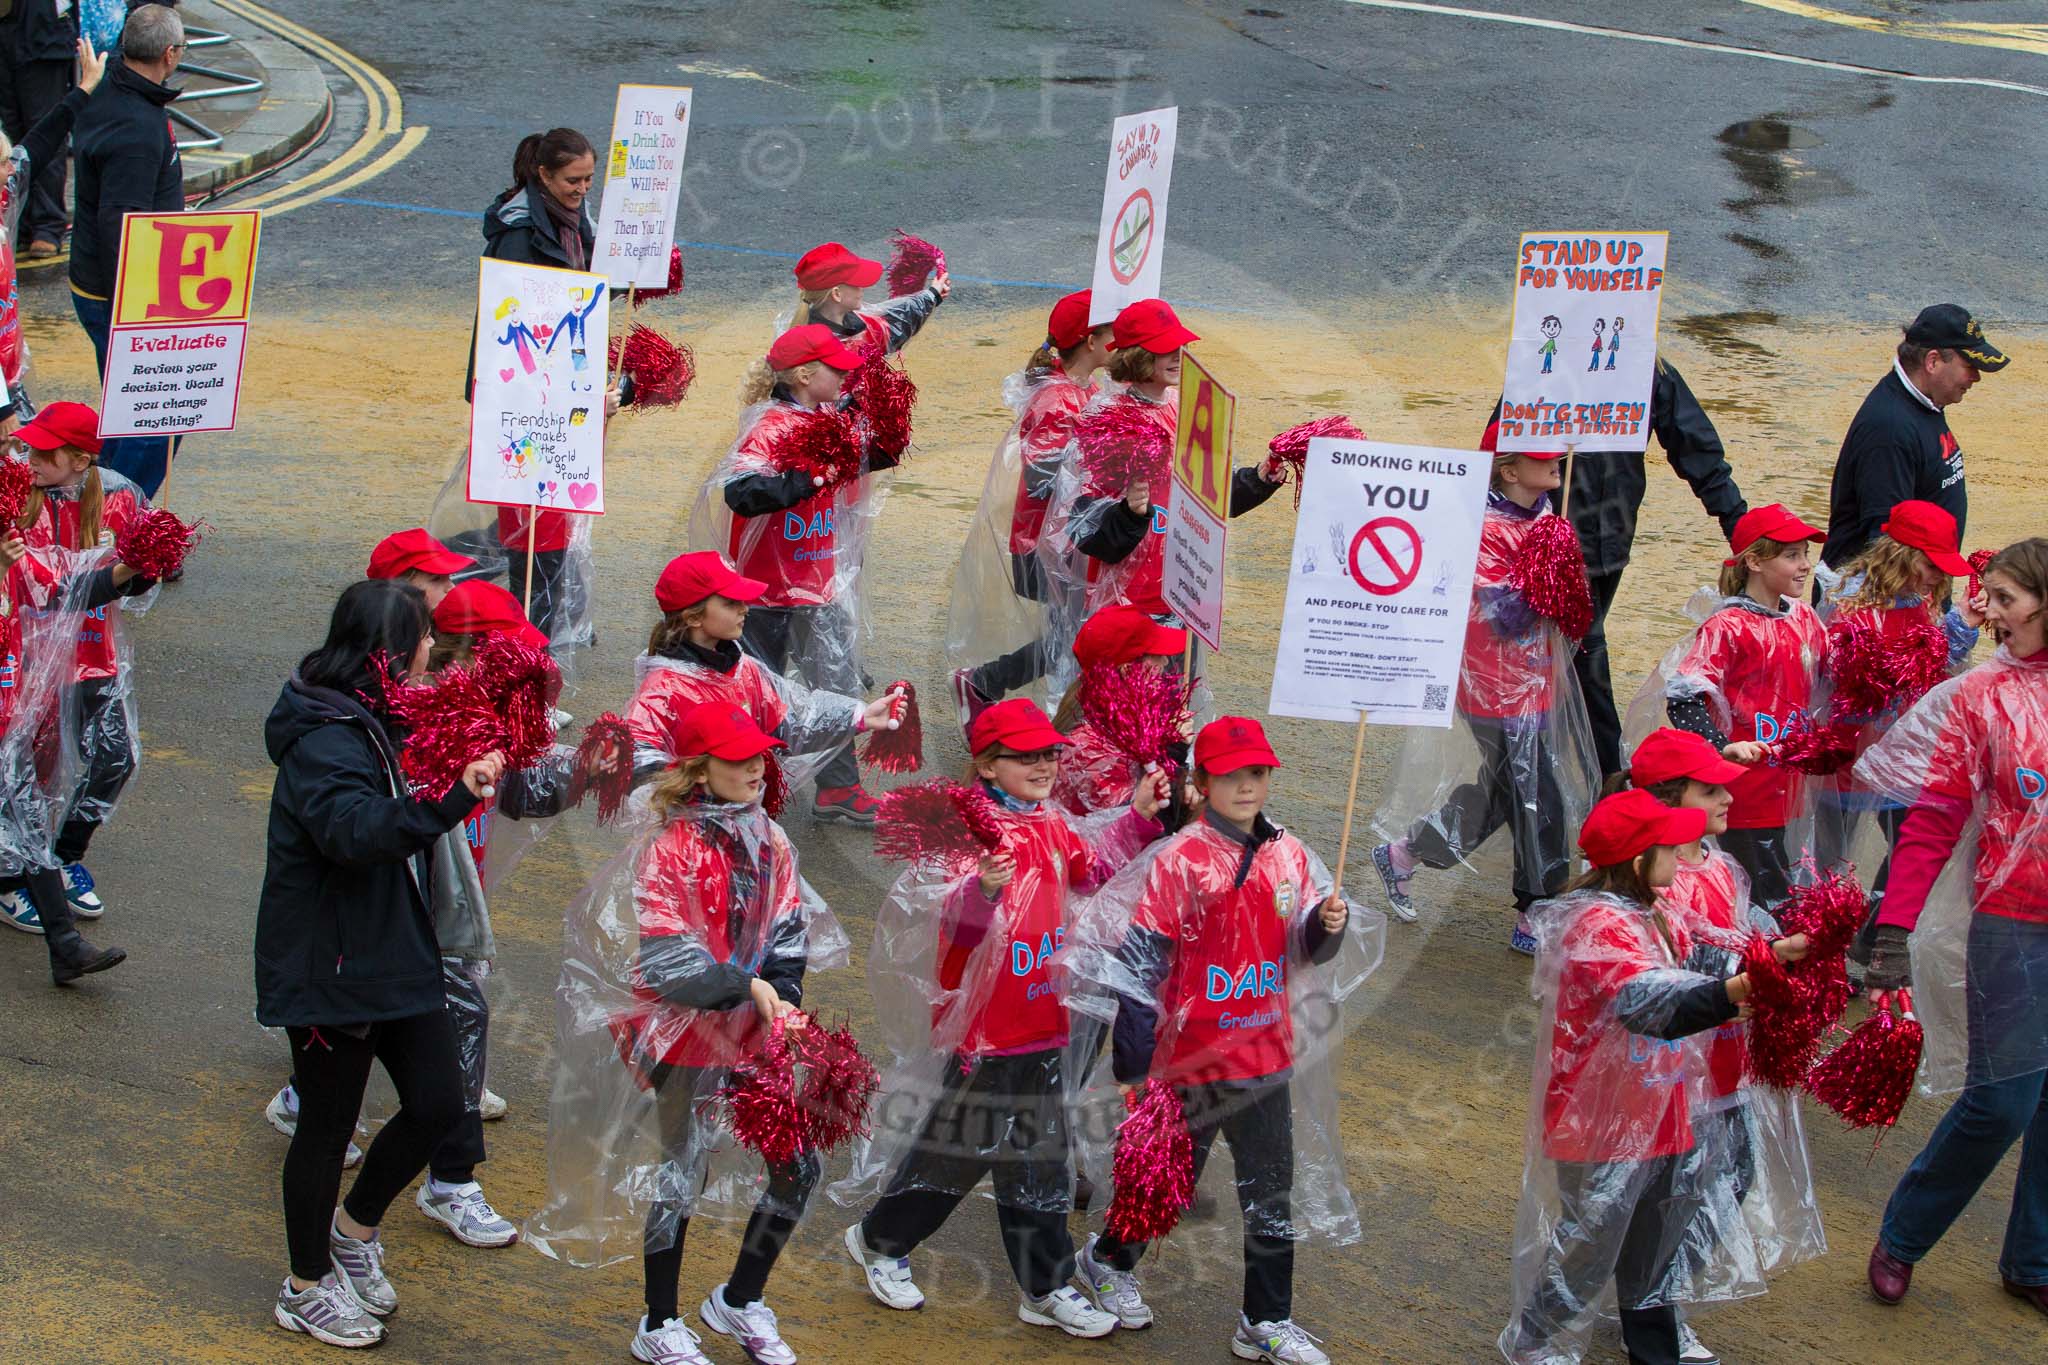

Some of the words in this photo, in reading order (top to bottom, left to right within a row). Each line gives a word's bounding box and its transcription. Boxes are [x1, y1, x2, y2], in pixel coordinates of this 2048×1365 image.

[634, 110, 645, 125] If
[645, 111, 664, 126] You
[632, 132, 658, 148] Drink
[661, 133, 676, 148] Too
[1116, 127, 1137, 160] SAY
[628, 154, 656, 170] Much
[657, 155, 674, 170] You
[631, 177, 651, 191] Will
[652, 177, 669, 191] Feel
[614, 220, 638, 235] Then
[608, 242, 621, 257] Be
[1522, 238, 1602, 266] STAND
[1605, 240, 1644, 266] UP
[145, 220, 234, 319] E
[1519, 265, 1559, 289] FOR
[1562, 266, 1664, 292] YOURSELF
[130, 333, 227, 353] Evaluate
[132, 364, 183, 375] Review
[186, 362, 218, 375] your
[120, 381, 181, 394] decision.
[185, 377, 225, 391] Would
[133, 400, 159, 412] you
[162, 397, 208, 410] change
[1502, 396, 1557, 421] DON'T
[1555, 402, 1613, 424] GIVE
[1614, 401, 1646, 421] IN
[133, 413, 203, 429] anything?
[501, 409, 566, 434] Friendship
[1501, 420, 1524, 437] TO
[529, 431, 567, 443] makes
[1181, 379, 1218, 506] A
[540, 443, 556, 455] the
[545, 449, 576, 465] world
[555, 463, 567, 474] go
[1330, 450, 1413, 472] SMOKING
[1418, 460, 1467, 477] KILLS
[562, 466, 590, 481] round
[1362, 483, 1430, 512] YOU
[784, 507, 837, 541] DAR
[1305, 598, 1328, 607] AND
[1330, 599, 1373, 611] PEOPLE
[1376, 604, 1398, 613] YOU
[1400, 606, 1427, 616] CARE
[1429, 608, 1449, 616] FOR
